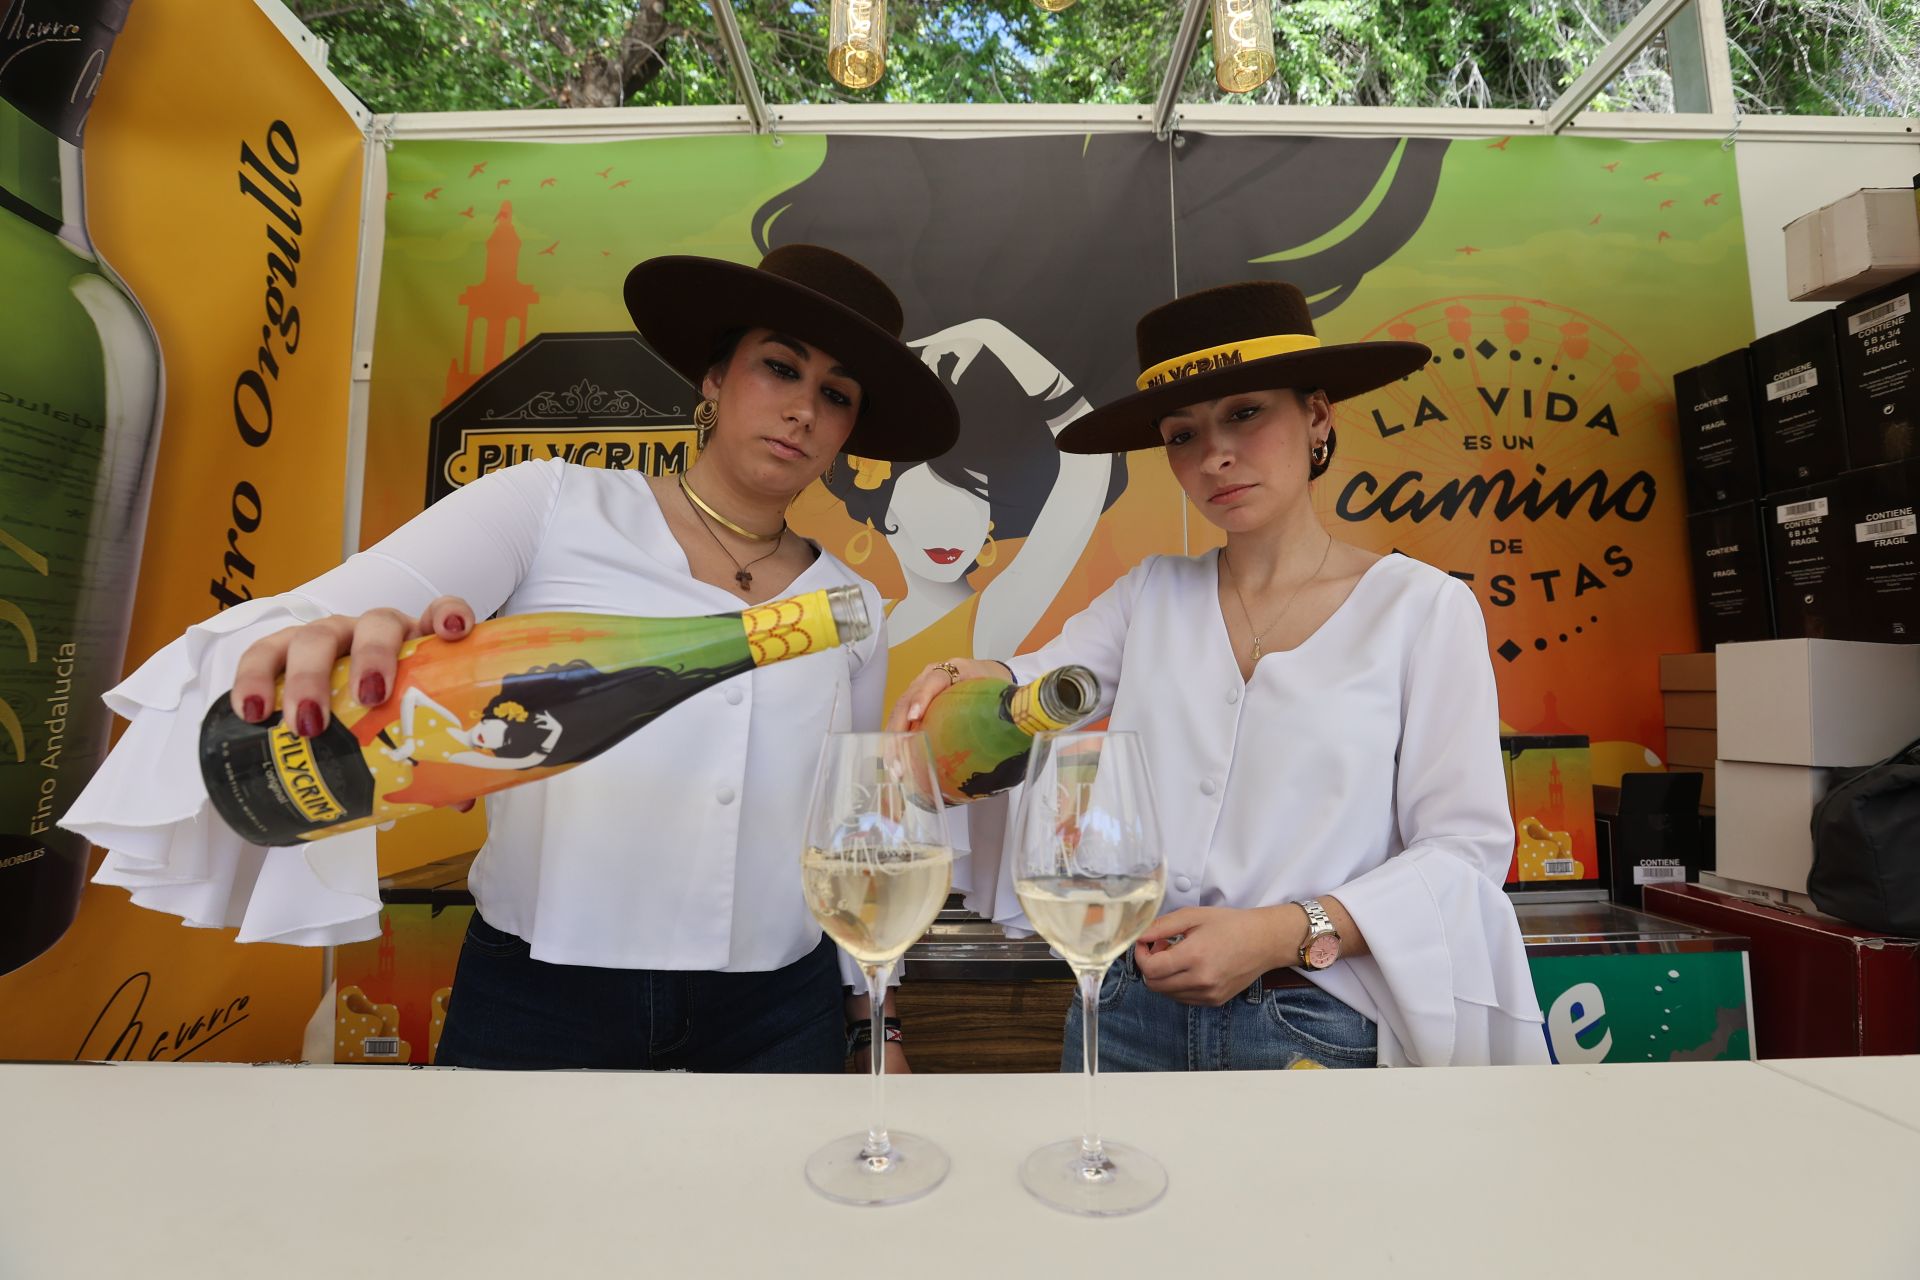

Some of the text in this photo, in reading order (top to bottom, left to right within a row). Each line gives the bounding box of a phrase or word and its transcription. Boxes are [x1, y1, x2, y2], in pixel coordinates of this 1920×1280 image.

[232, 119, 303, 448] Orgullo
[1858, 316, 1905, 339] CONTIENE
[1866, 339, 1901, 356] FRAGIL
[1773, 361, 1813, 382] CONTIENE
[1693, 394, 1729, 412] CONTIENE
[1781, 388, 1811, 404] FRAGIL
[1371, 386, 1620, 438] LA VIDA
[1701, 419, 1728, 432] FRAGIL
[1463, 435, 1535, 451] ES UN
[1334, 463, 1657, 524] camino
[1865, 507, 1913, 522] CONTIENE
[1783, 516, 1823, 530] CONTIENE
[1489, 538, 1523, 555] DE
[1790, 536, 1820, 547] FRAGIL
[1874, 537, 1909, 548] FRAGIL
[1706, 544, 1740, 557] CONTIENE
[1712, 568, 1738, 579] FRAGIL
[30, 642, 77, 836] Fino Andalucía
[1640, 858, 1681, 867] CONTIENE
